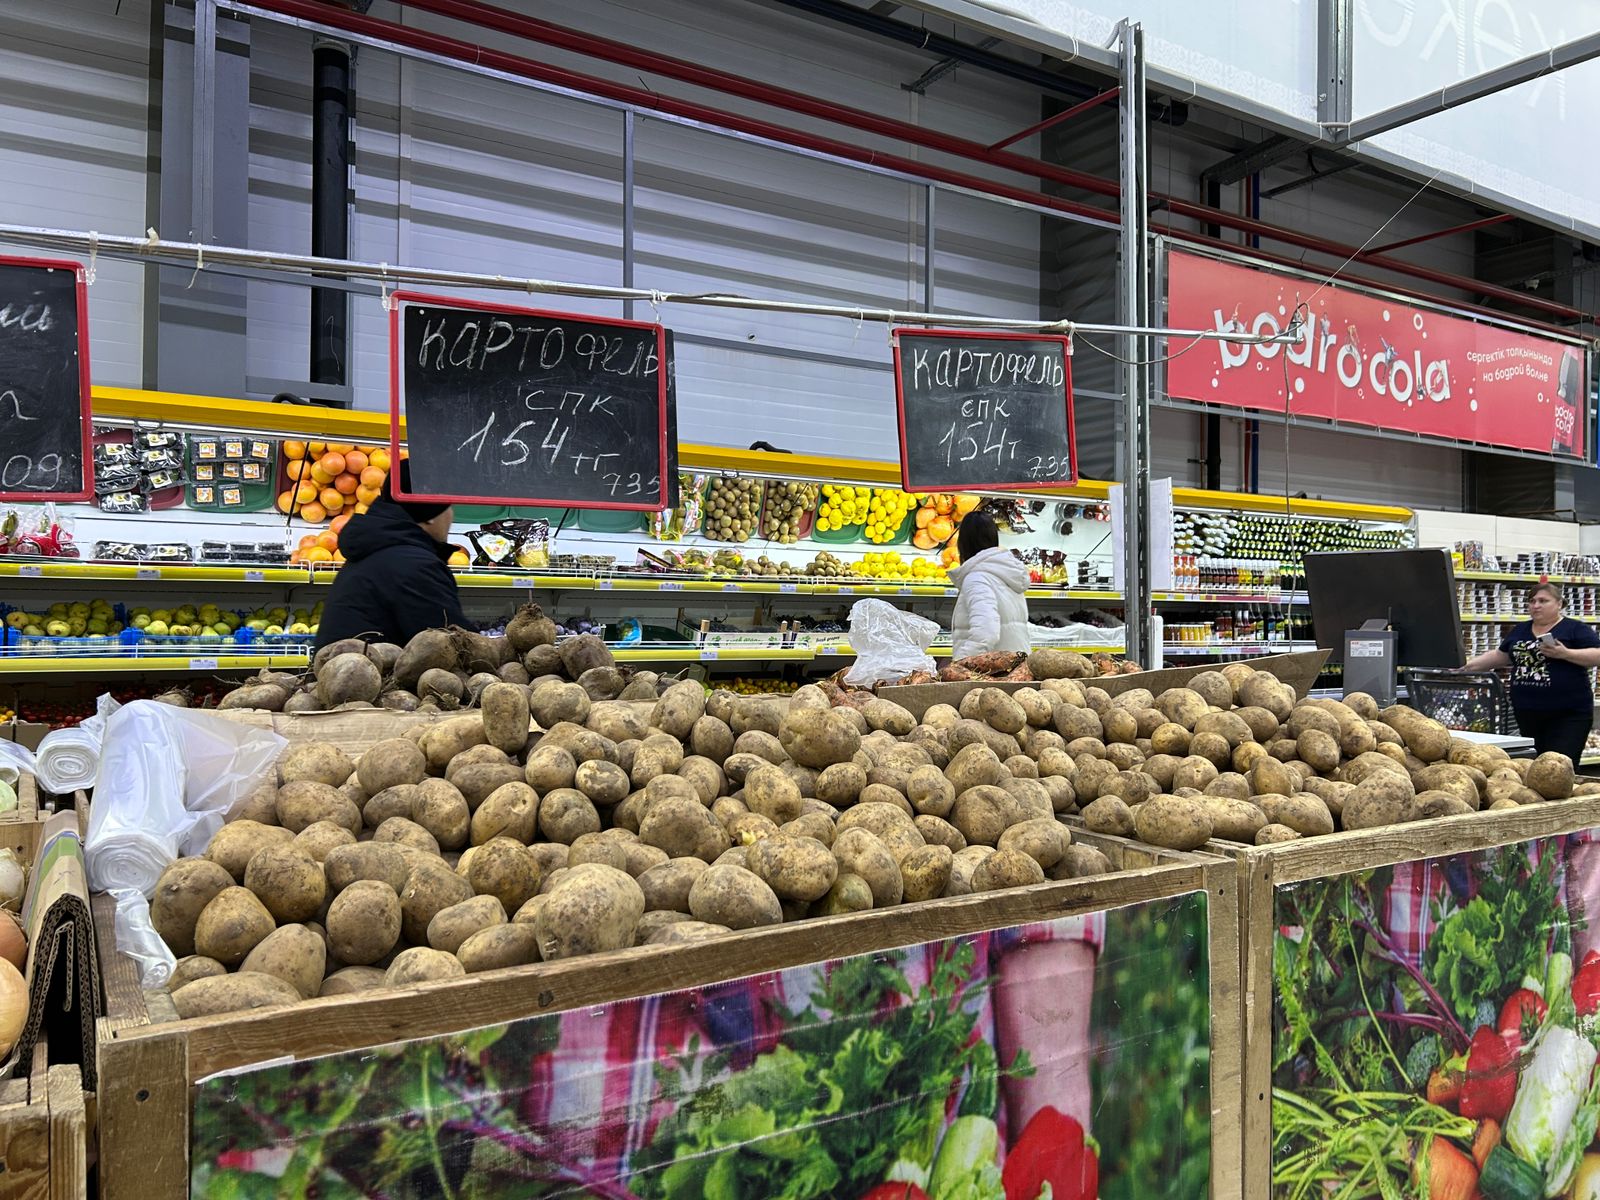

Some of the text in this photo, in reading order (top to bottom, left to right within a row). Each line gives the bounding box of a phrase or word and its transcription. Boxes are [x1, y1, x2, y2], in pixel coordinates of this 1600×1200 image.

[1213, 308, 1451, 402] bodro cola
[1466, 347, 1553, 366] сергектік толқынында
[1483, 363, 1549, 382] на бодрой волне
[1554, 405, 1575, 426] bodro
[1555, 417, 1572, 434] cola
[602, 472, 661, 496] 735
